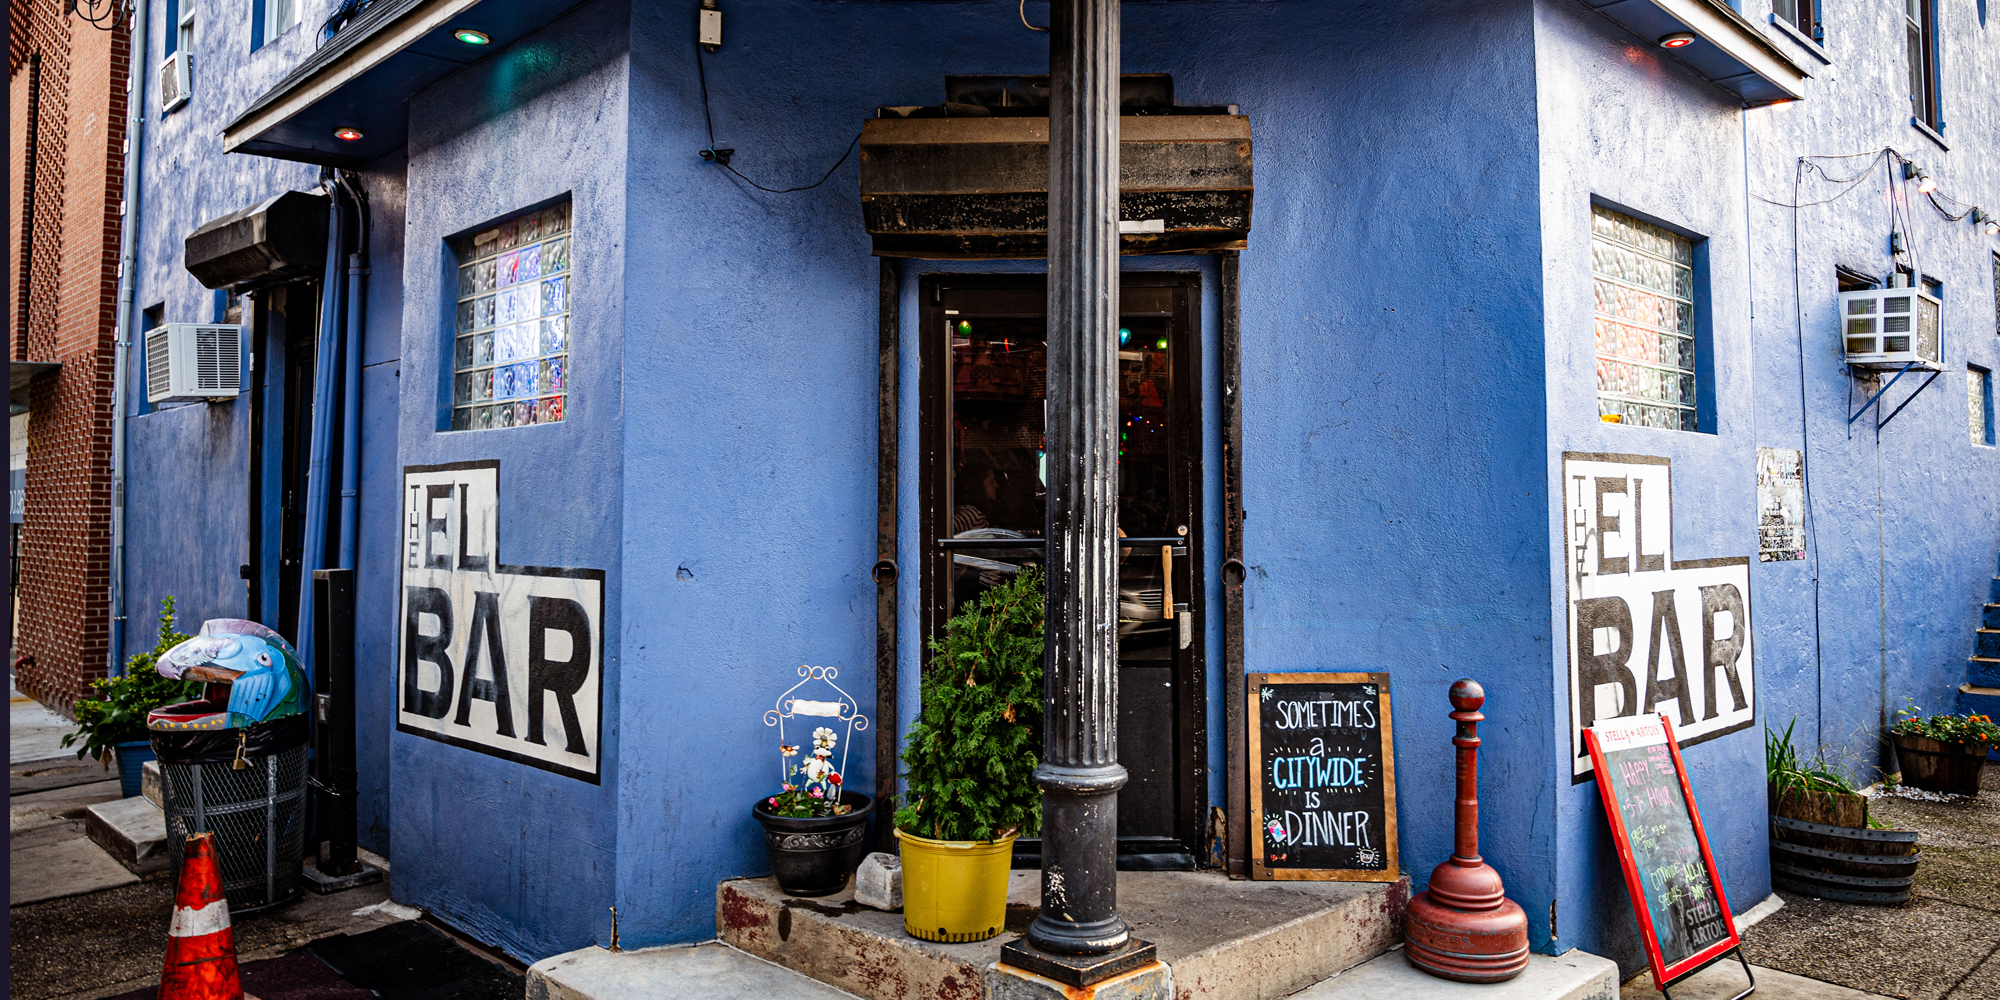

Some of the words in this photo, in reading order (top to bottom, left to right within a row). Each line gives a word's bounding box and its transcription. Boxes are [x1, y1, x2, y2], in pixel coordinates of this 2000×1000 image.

[409, 485, 421, 568] THE
[424, 480, 491, 580] EL
[1573, 474, 1588, 577] THE
[1594, 474, 1665, 577] EL
[402, 585, 591, 757] BAR
[1573, 583, 1748, 759] BAR
[1275, 700, 1376, 729] SOMETIMES
[1309, 737, 1325, 757] a
[1604, 731, 1629, 742] STELLA
[1636, 725, 1660, 737] ARTOIS
[1273, 756, 1366, 789] CITYWIDE
[1618, 759, 1651, 788] HAPPY
[1305, 791, 1320, 809] IS
[1645, 785, 1674, 811] HOUR
[1284, 810, 1370, 848] DINNER
[1650, 863, 1681, 891] CITYWIDE
[1686, 900, 1721, 926] STELLA
[1692, 918, 1727, 947] ARTOIS
